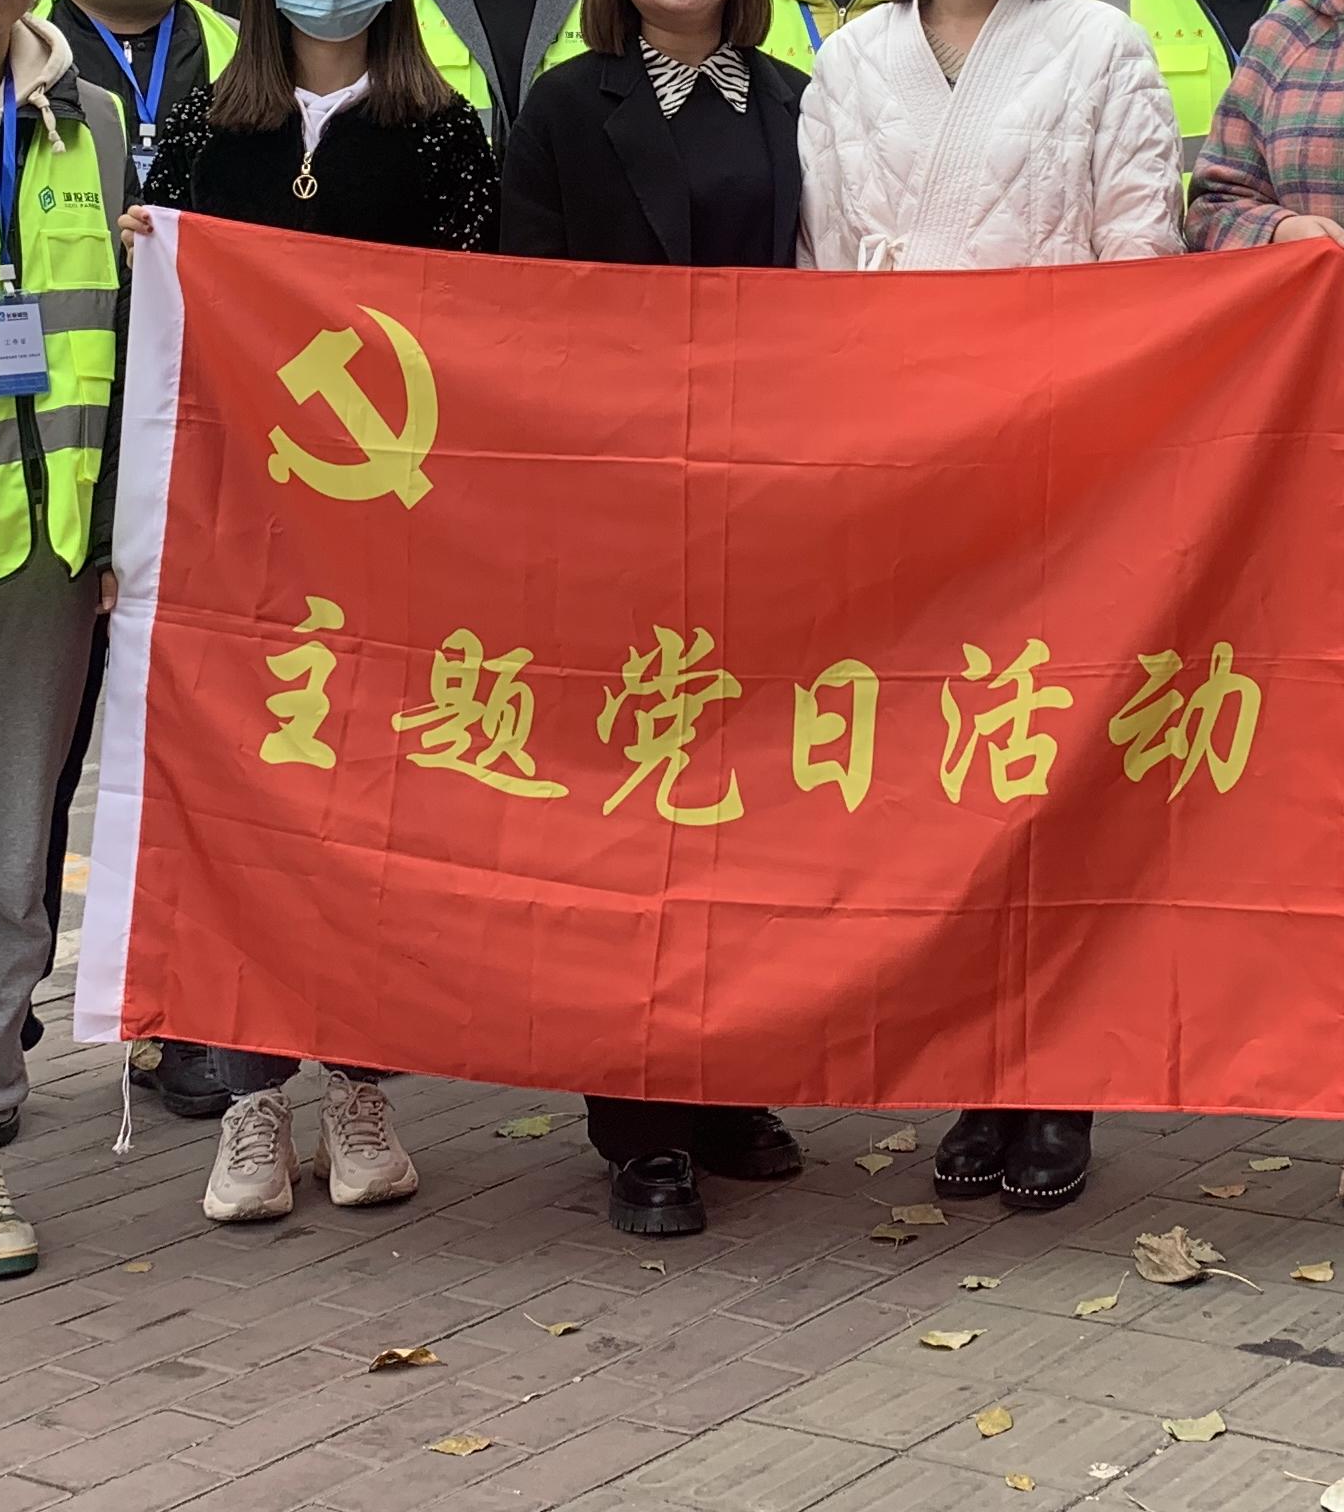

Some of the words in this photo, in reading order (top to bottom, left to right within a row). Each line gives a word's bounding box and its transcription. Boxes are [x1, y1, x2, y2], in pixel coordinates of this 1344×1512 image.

[258, 595, 1262, 827] 主题党日活动
